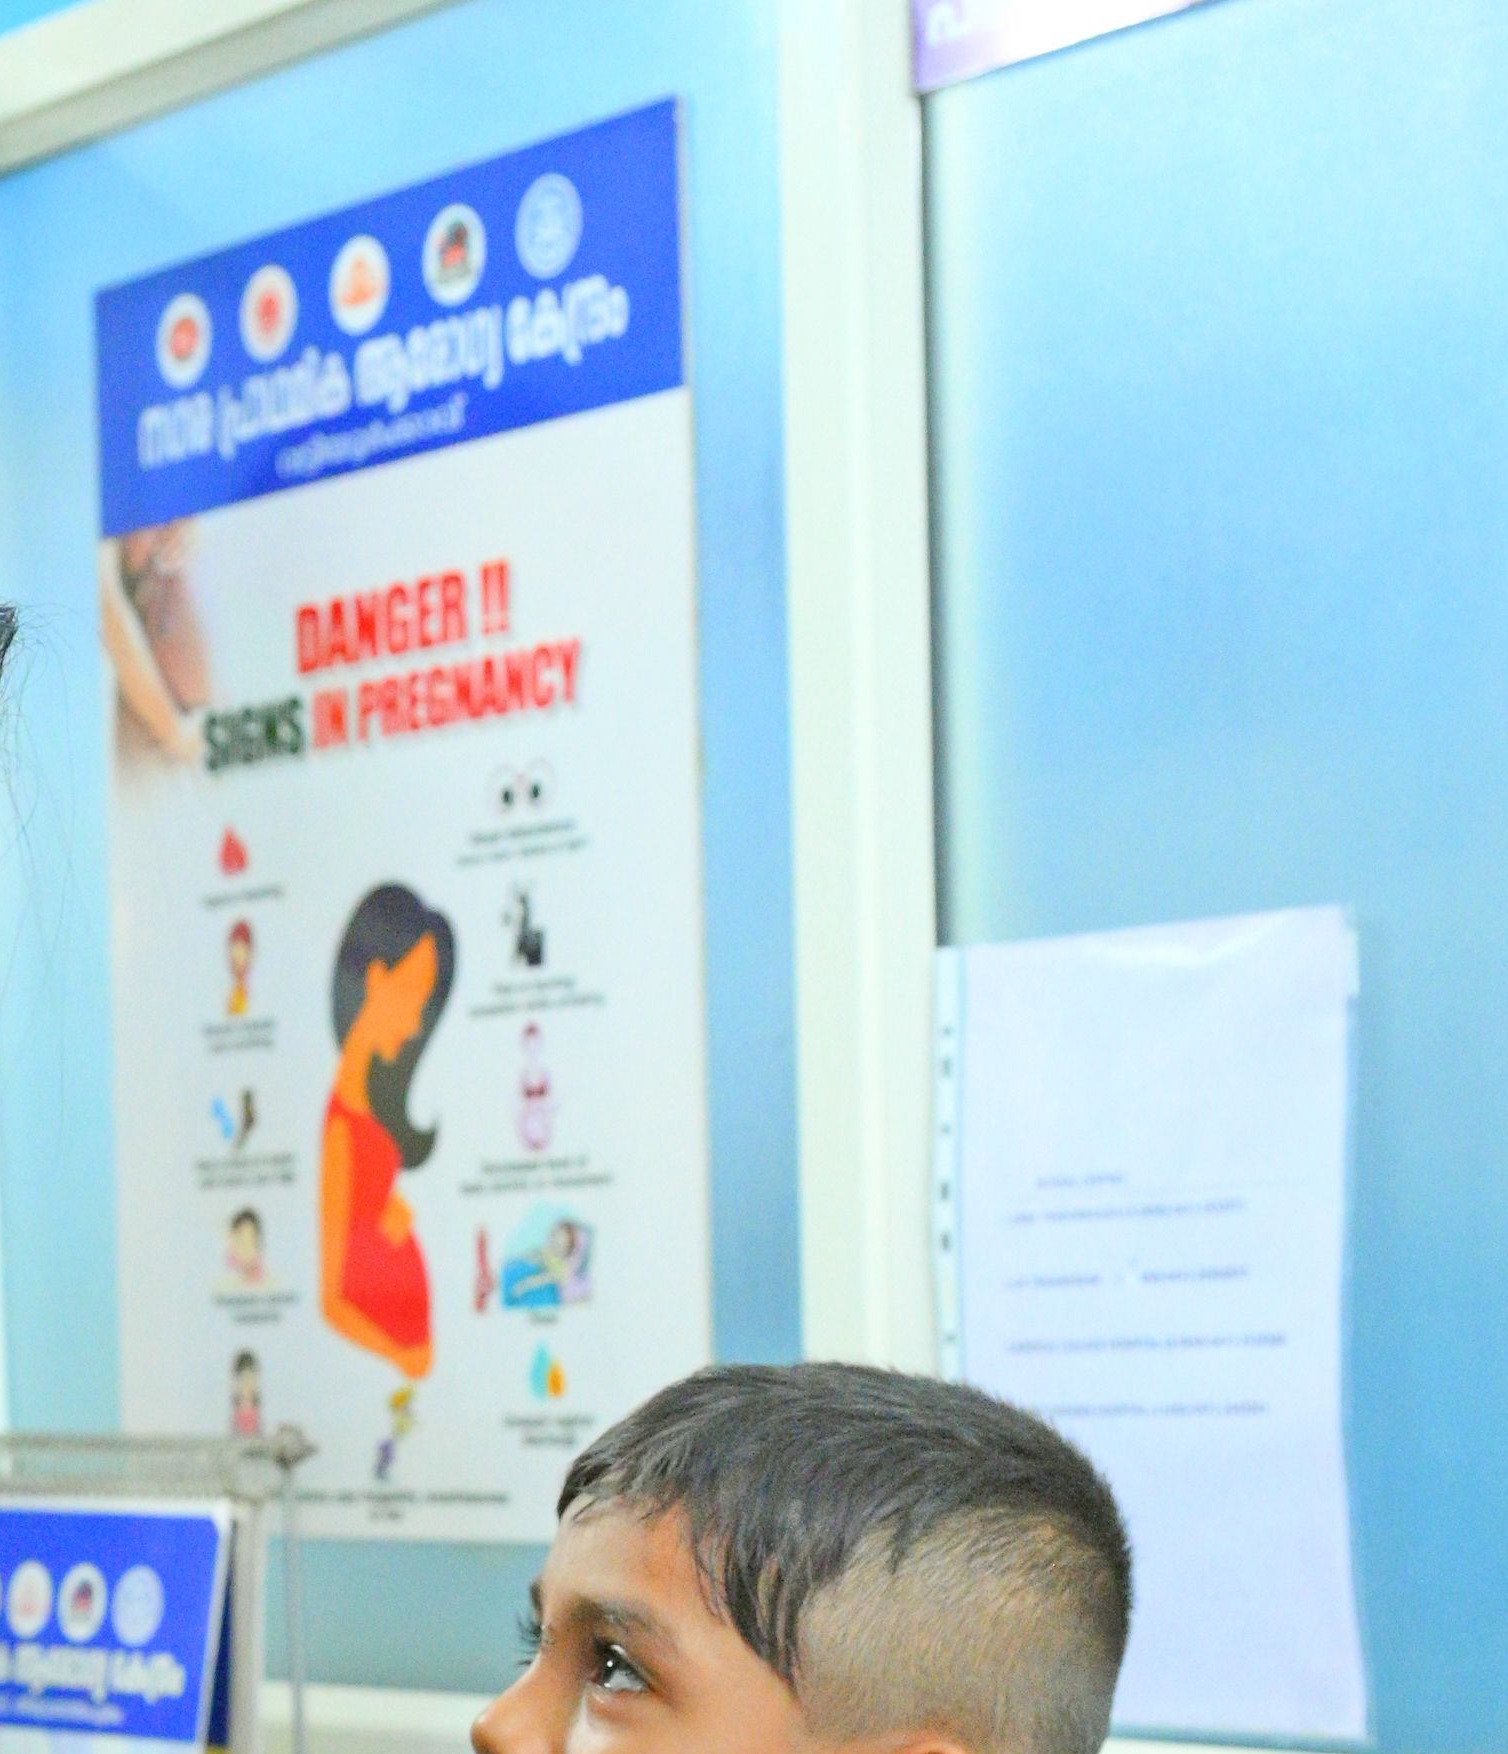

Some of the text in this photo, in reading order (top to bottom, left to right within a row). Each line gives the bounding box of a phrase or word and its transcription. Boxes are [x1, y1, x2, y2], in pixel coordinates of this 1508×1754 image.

[295, 557, 511, 676] DANGER !!
[203, 637, 582, 773] SIGNS IN PREGNANCY
